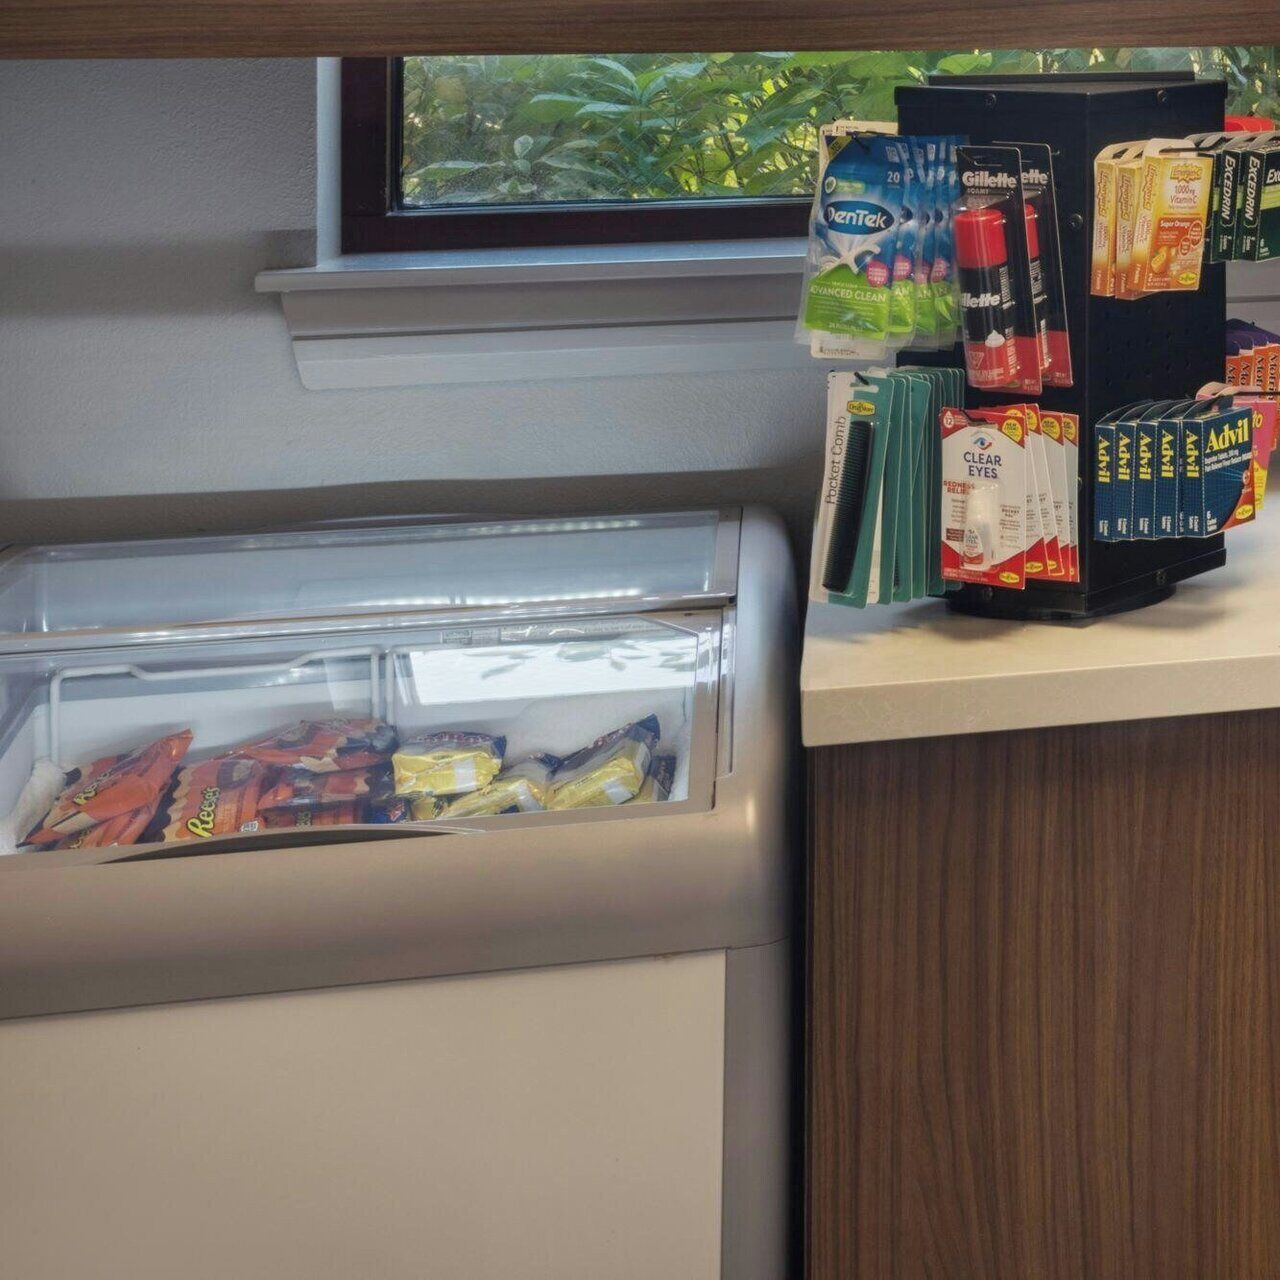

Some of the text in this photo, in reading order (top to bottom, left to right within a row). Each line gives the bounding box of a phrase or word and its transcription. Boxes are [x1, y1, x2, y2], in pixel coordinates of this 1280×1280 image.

[962, 171, 1017, 188] Gillette
[1222, 156, 1236, 219] EXCEDRIN
[1245, 156, 1260, 220] EXCEDRIN
[828, 209, 888, 228] DenTek
[854, 290, 886, 302] CLEAN
[1205, 418, 1250, 452] Advil
[826, 416, 846, 504] Pocket Comb
[964, 451, 1001, 466] CLEAR
[968, 465, 998, 479] EYES
[1098, 436, 1110, 483] Advil
[1118, 433, 1130, 480] Advil
